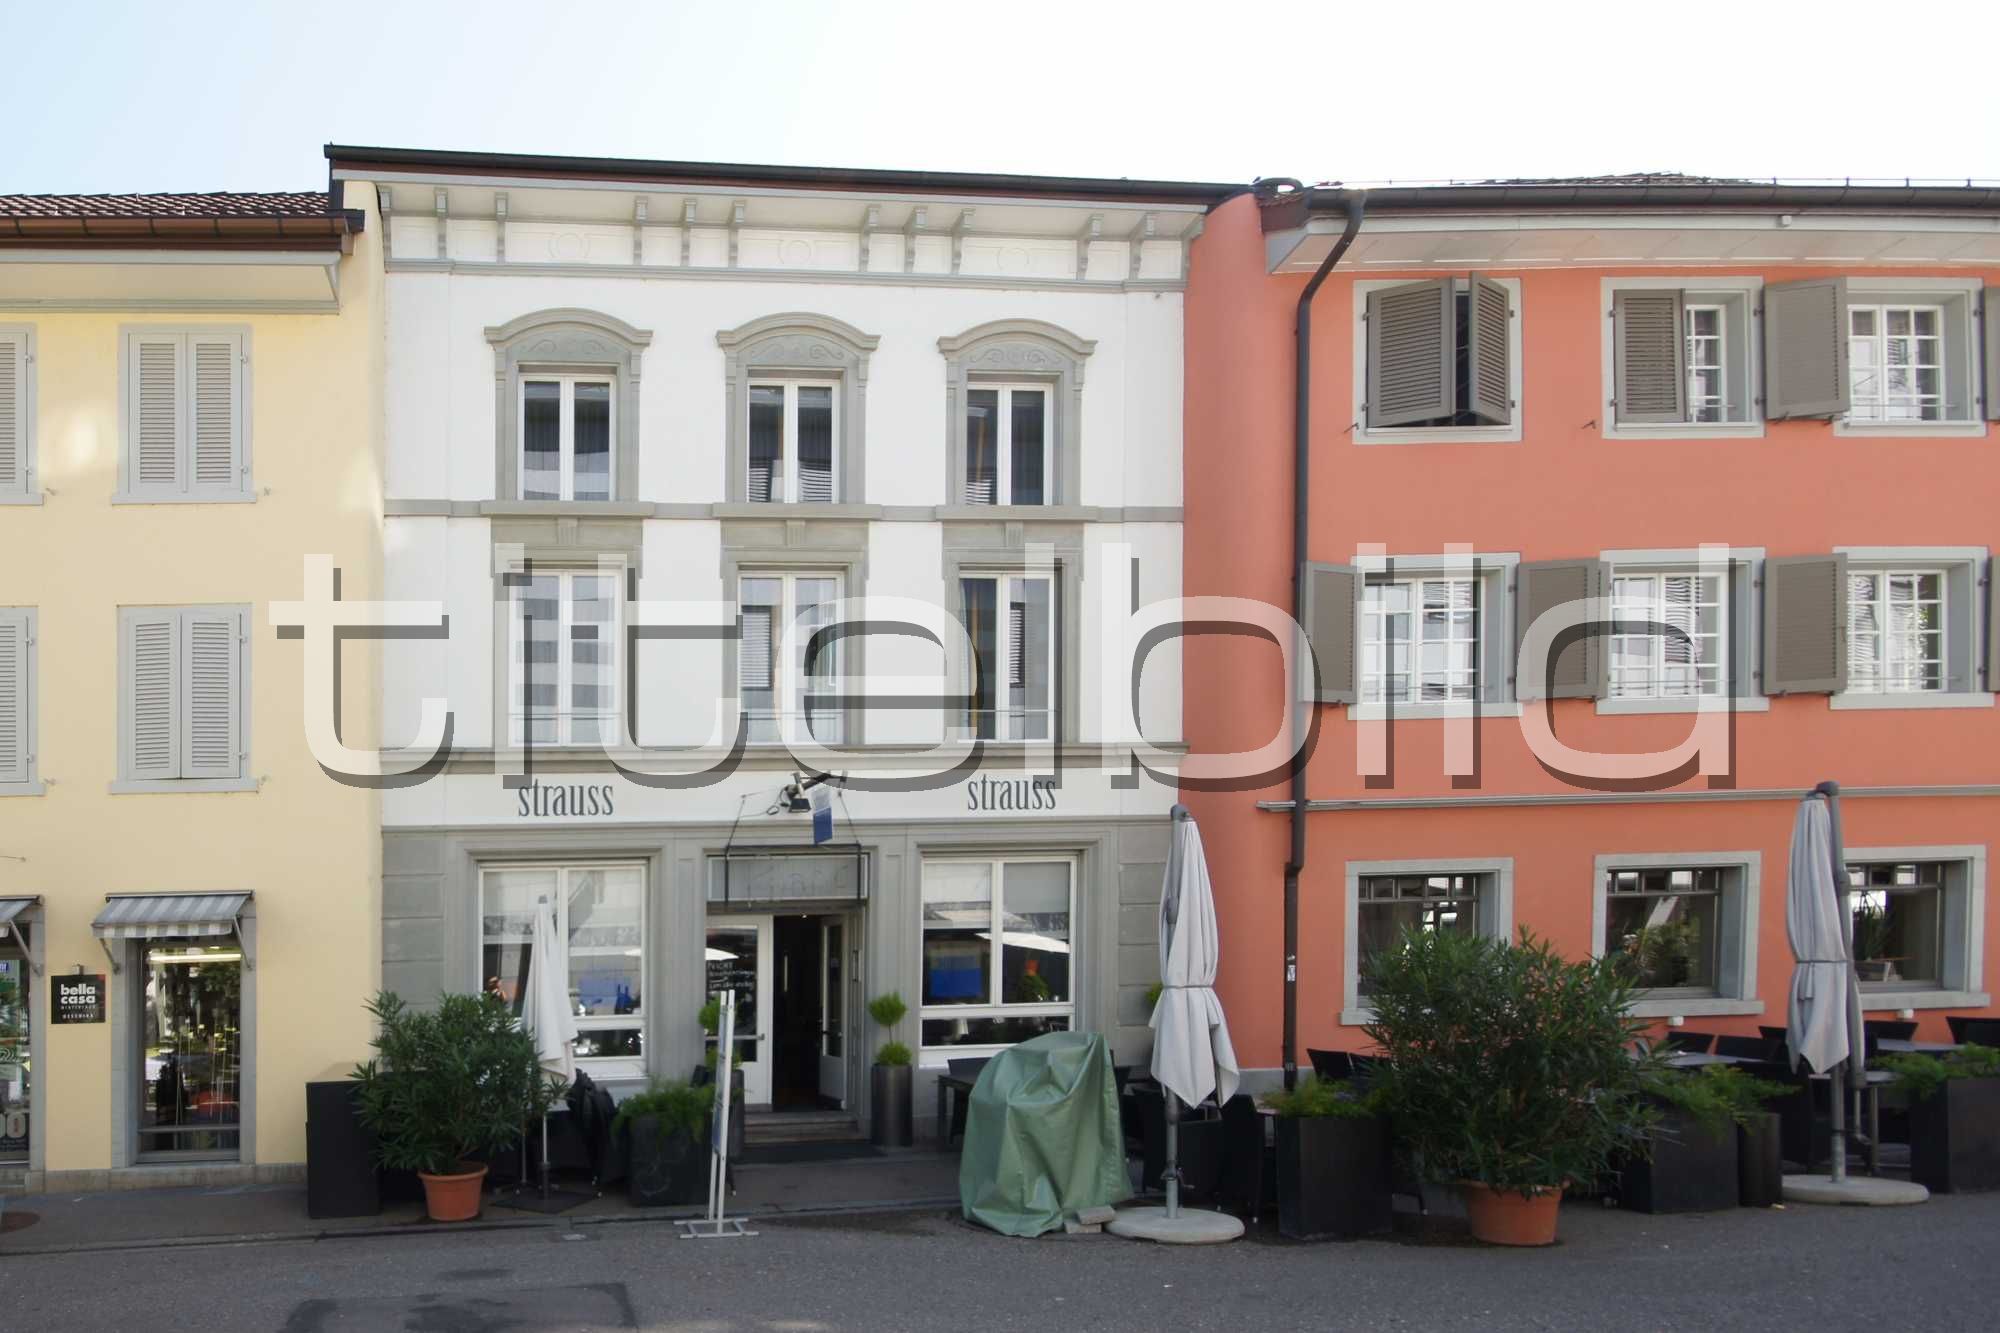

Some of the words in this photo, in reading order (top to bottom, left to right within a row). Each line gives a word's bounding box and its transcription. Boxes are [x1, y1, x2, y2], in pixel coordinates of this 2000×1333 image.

[518, 778, 614, 817] strauss
[967, 773, 1057, 810] strauss
[60, 983, 96, 995] bella
[60, 995, 96, 1005] casa
